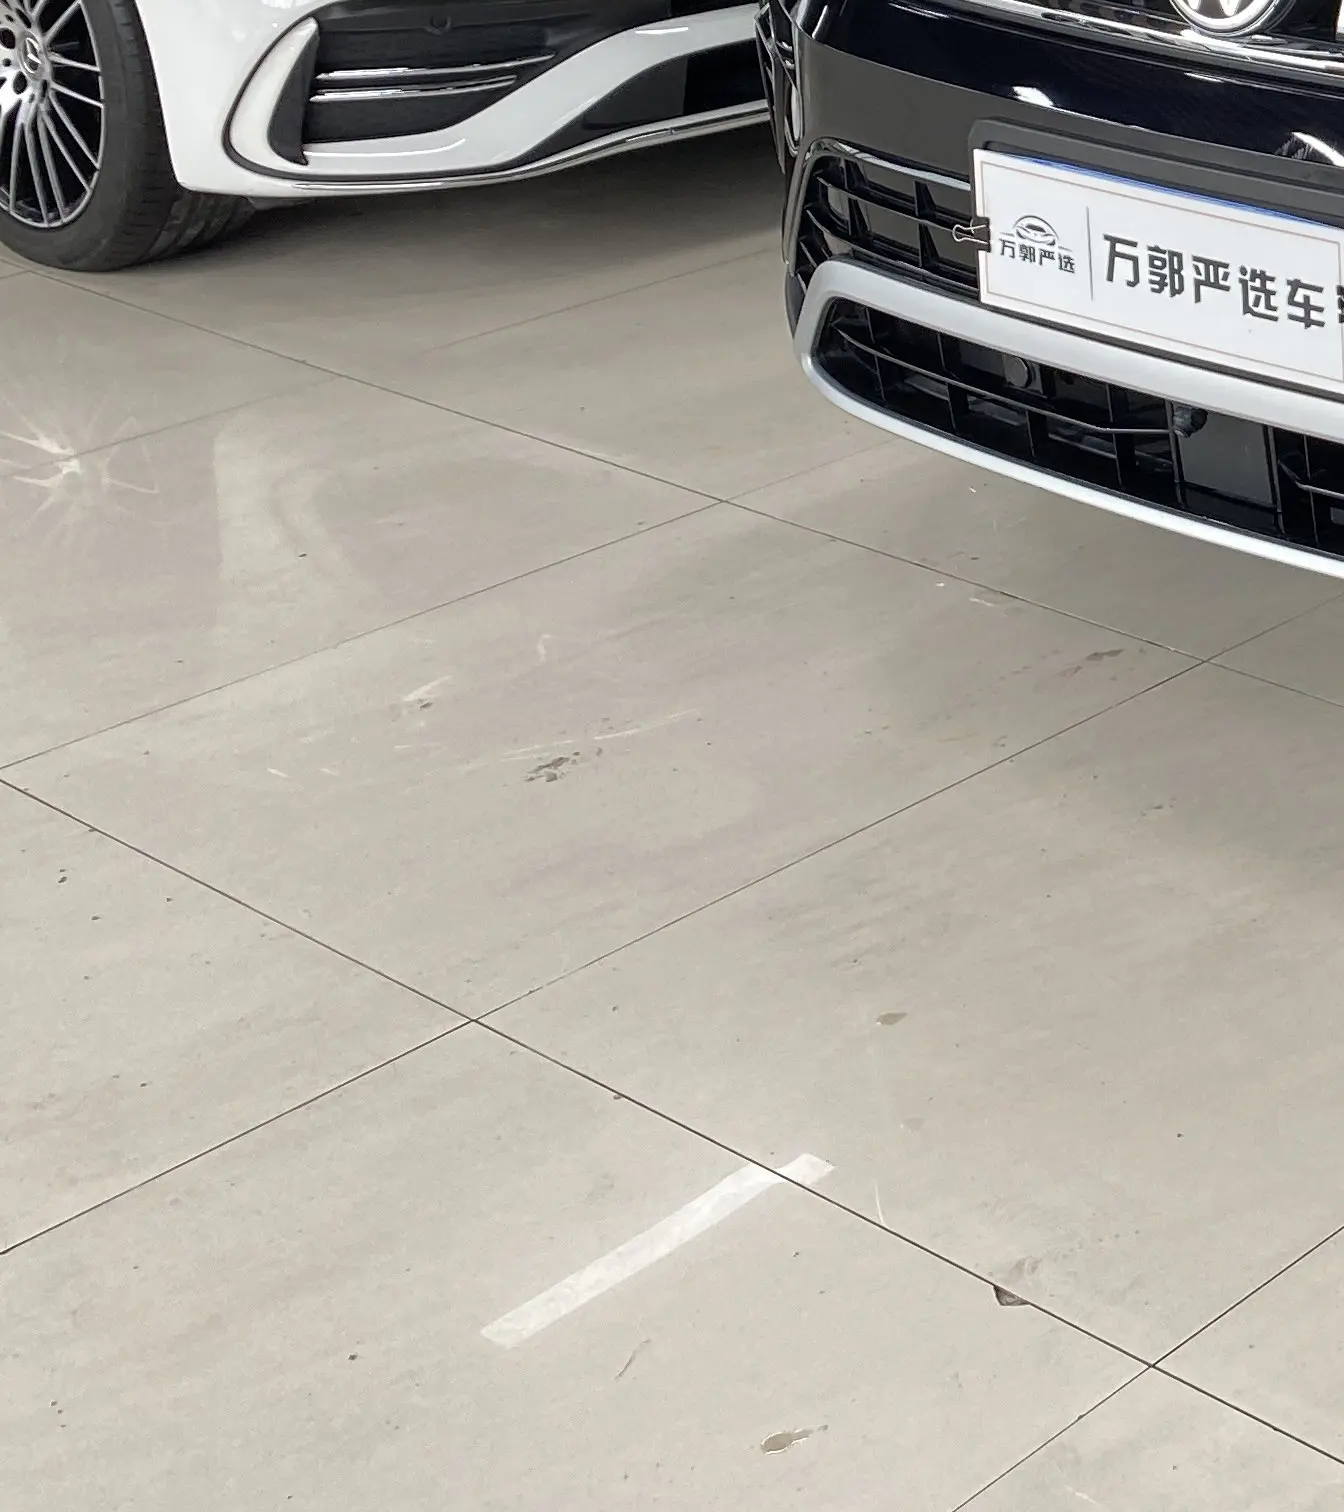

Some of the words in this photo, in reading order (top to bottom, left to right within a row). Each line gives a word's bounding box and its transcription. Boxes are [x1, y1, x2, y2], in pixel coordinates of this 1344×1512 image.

[997, 236, 1077, 275] 万郭严选
[1102, 233, 1327, 330] 万郭严选车
